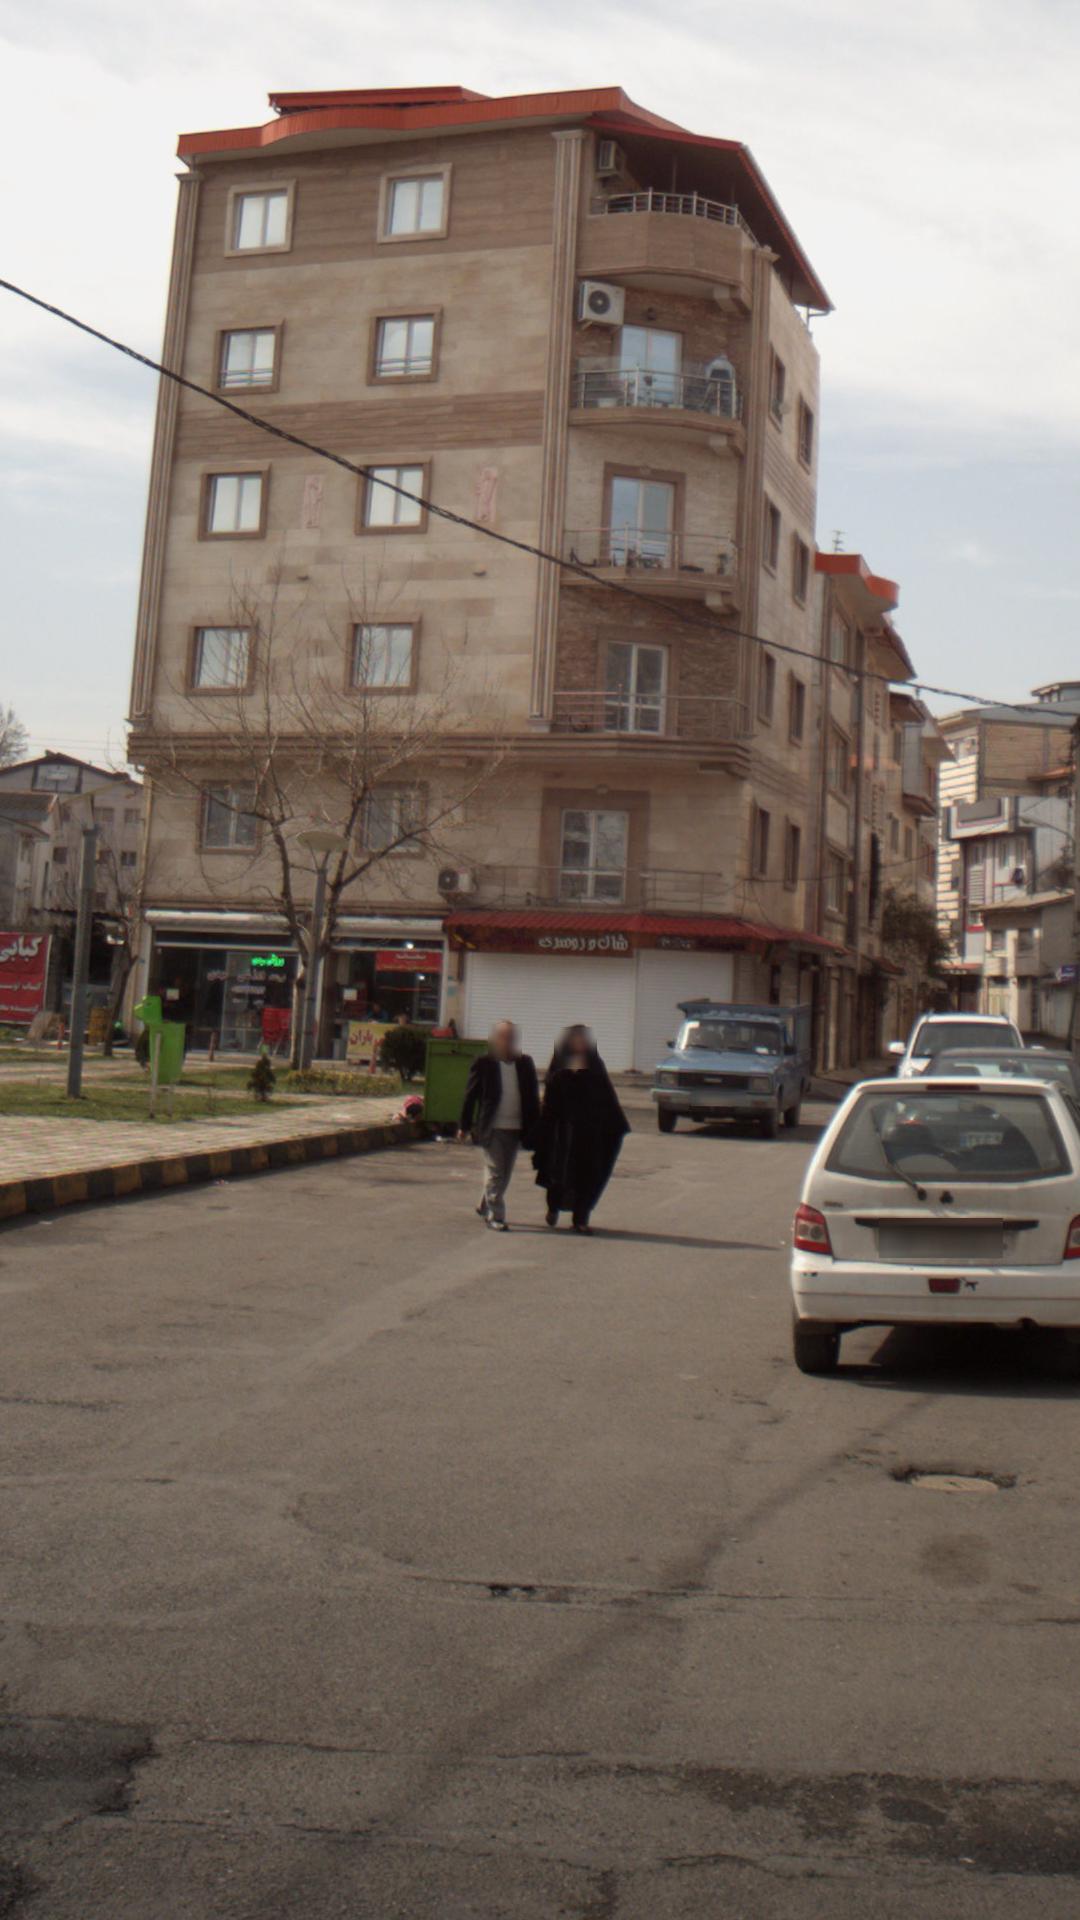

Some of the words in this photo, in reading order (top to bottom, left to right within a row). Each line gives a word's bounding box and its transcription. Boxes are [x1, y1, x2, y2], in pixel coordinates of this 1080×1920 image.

[538, 935, 586, 950] روسری
[587, 938, 597, 951] و
[598, 934, 629, 951] شال
